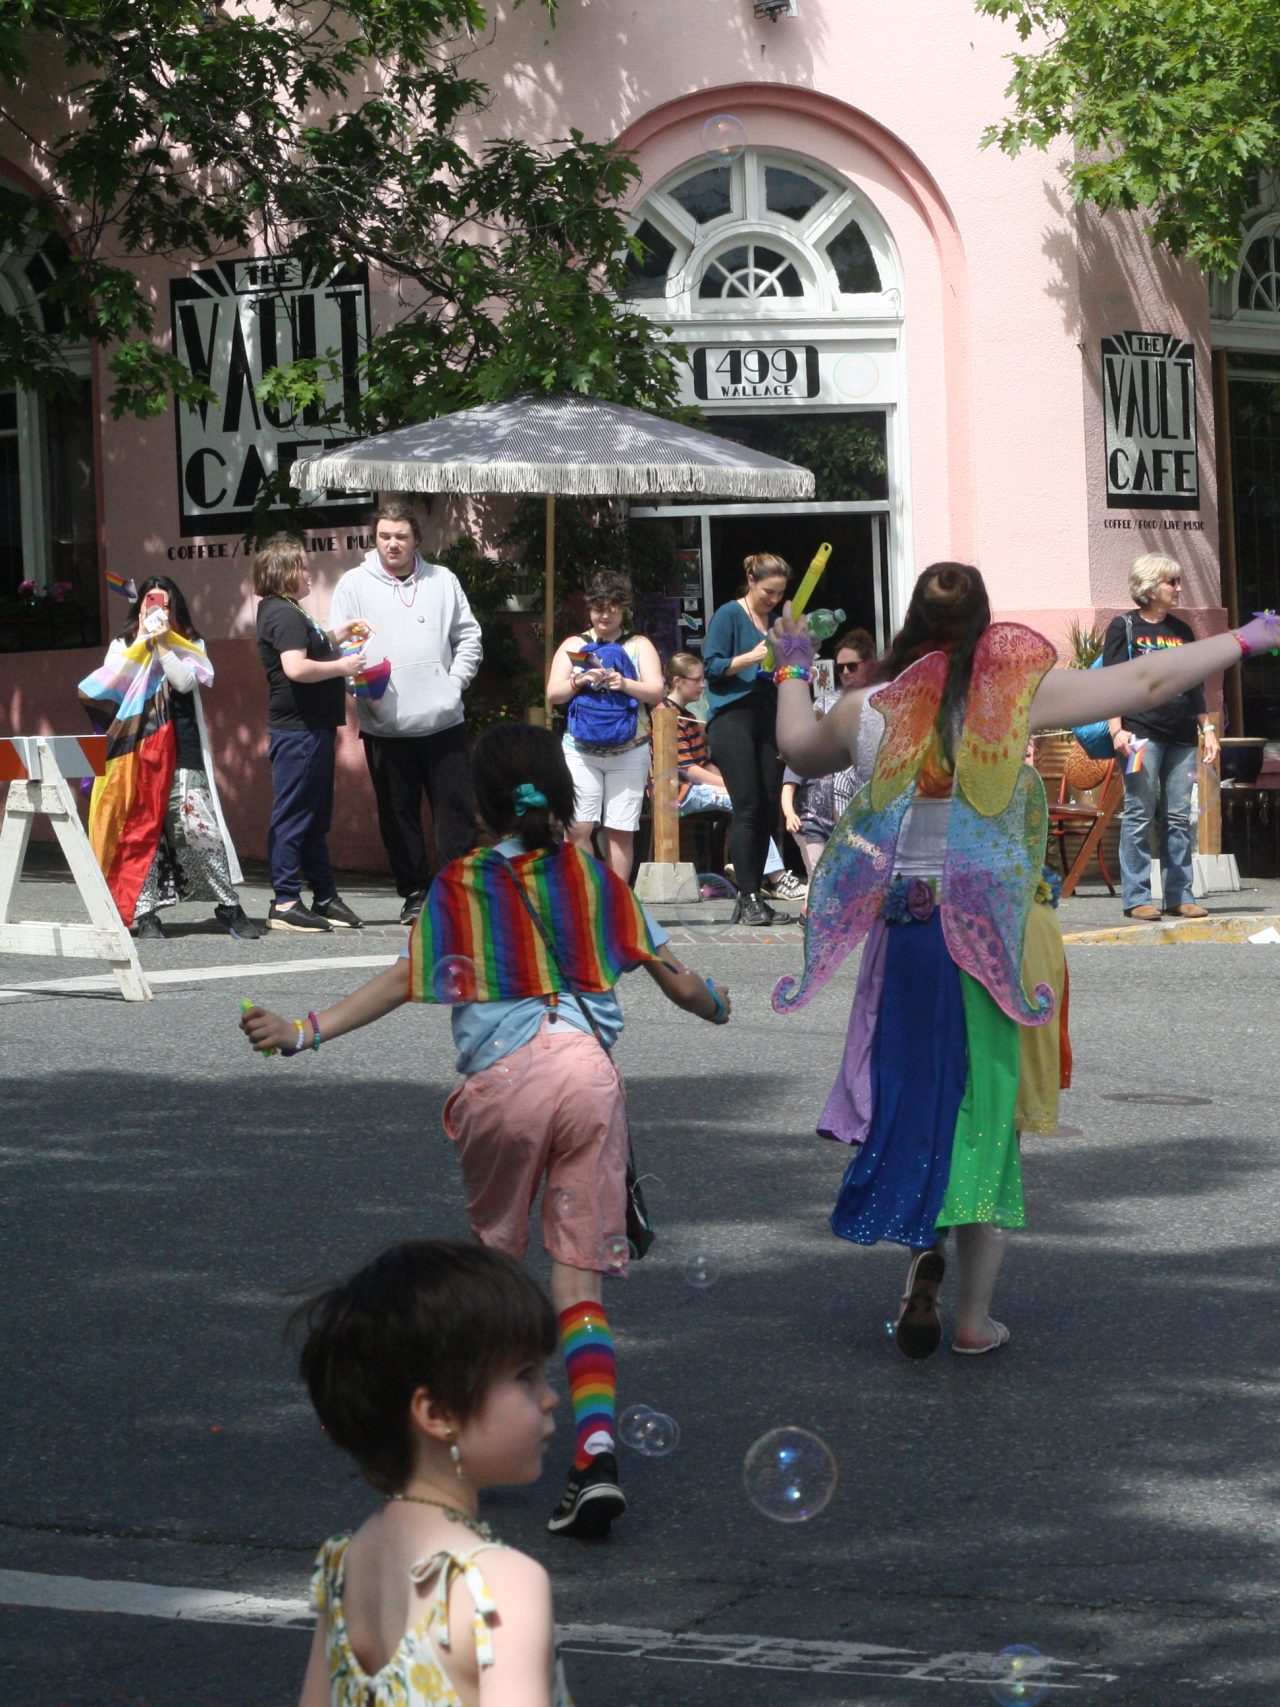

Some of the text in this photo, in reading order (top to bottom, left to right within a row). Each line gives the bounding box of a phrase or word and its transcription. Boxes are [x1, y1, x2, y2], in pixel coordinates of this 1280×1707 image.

[244, 263, 293, 286] THE
[1137, 336, 1161, 352] THE
[715, 348, 798, 385] 499
[720, 384, 793, 398] WALLACE
[1105, 357, 1192, 440] VAULT
[1108, 447, 1196, 493] CAFE
[1103, 519, 1131, 529] COFFEE
[1138, 519, 1158, 530] FOOD
[1164, 520, 1180, 530] LIVE
[1183, 520, 1205, 530] MUSIC
[167, 543, 229, 561] COFFEE
